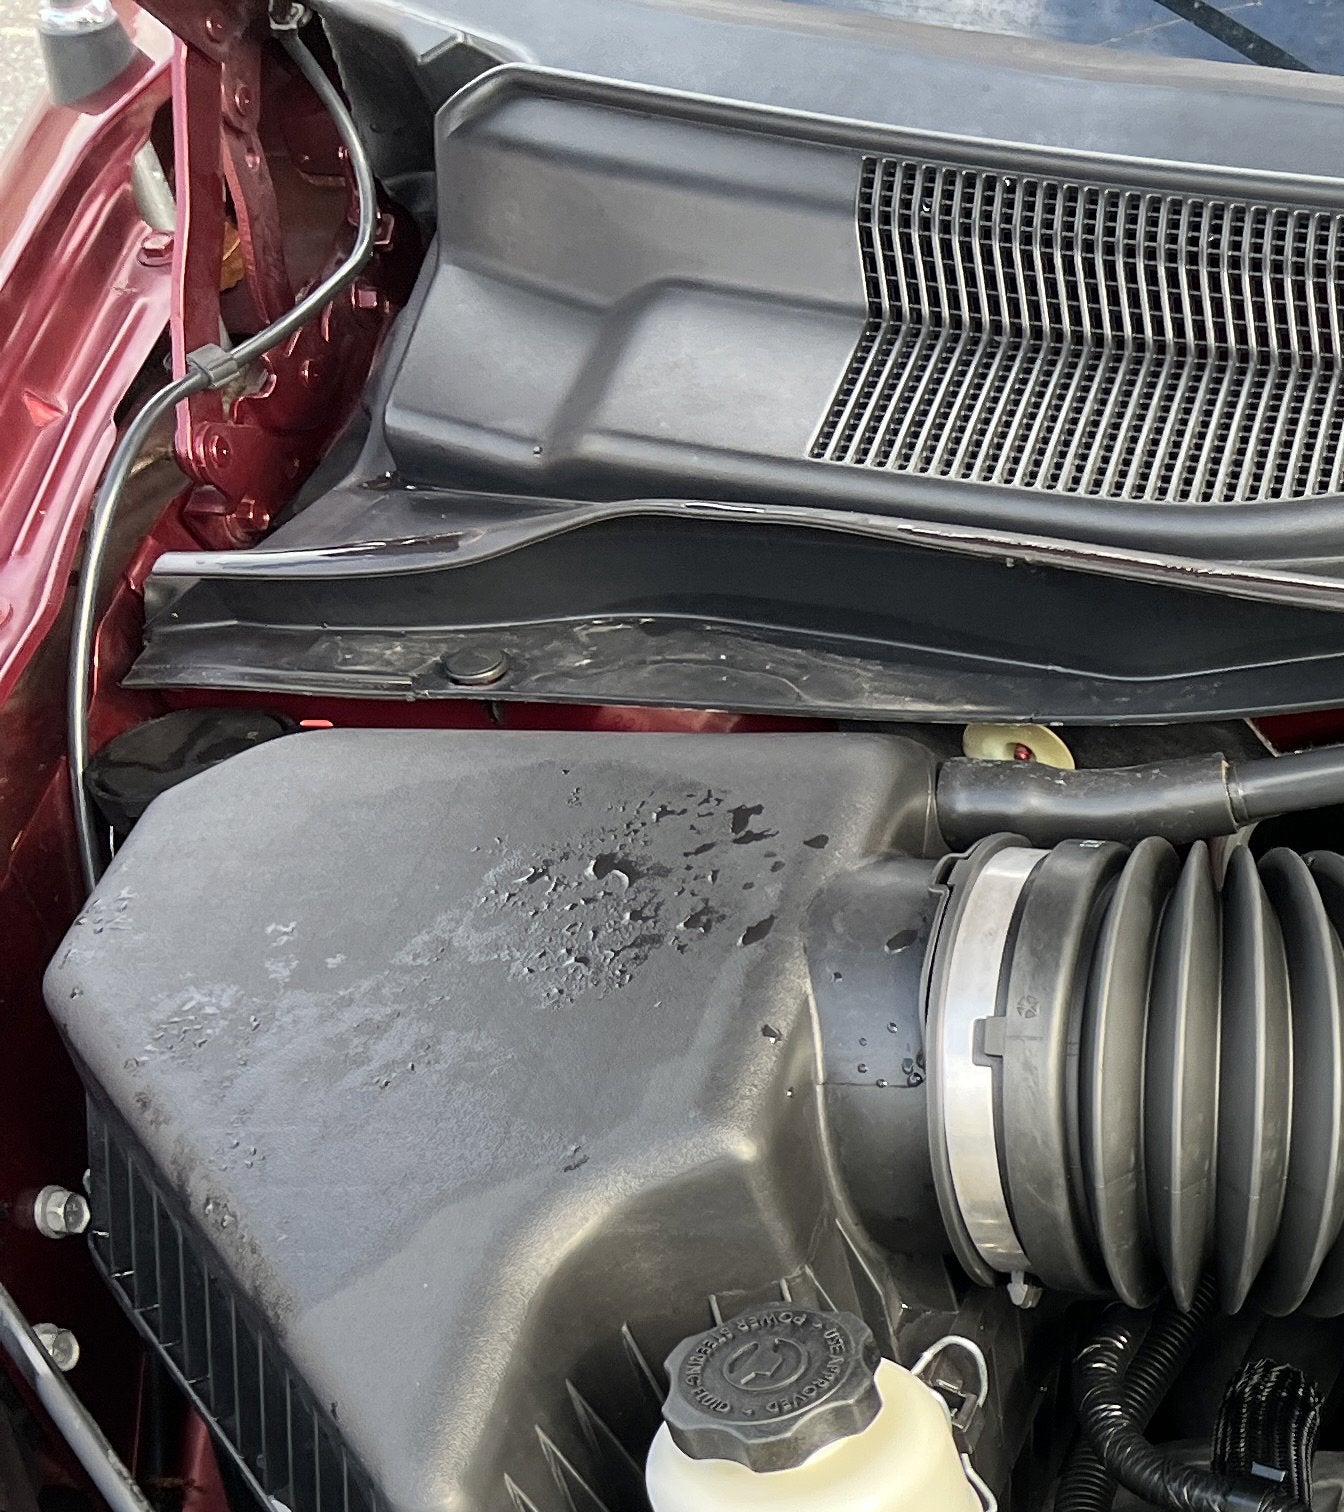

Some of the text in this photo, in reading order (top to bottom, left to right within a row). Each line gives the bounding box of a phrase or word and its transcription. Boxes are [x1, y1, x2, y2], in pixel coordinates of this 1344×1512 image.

[685, 1311, 808, 1413] POWER STEERING FLUID
[766, 1328, 846, 1414] USE APPROVED
